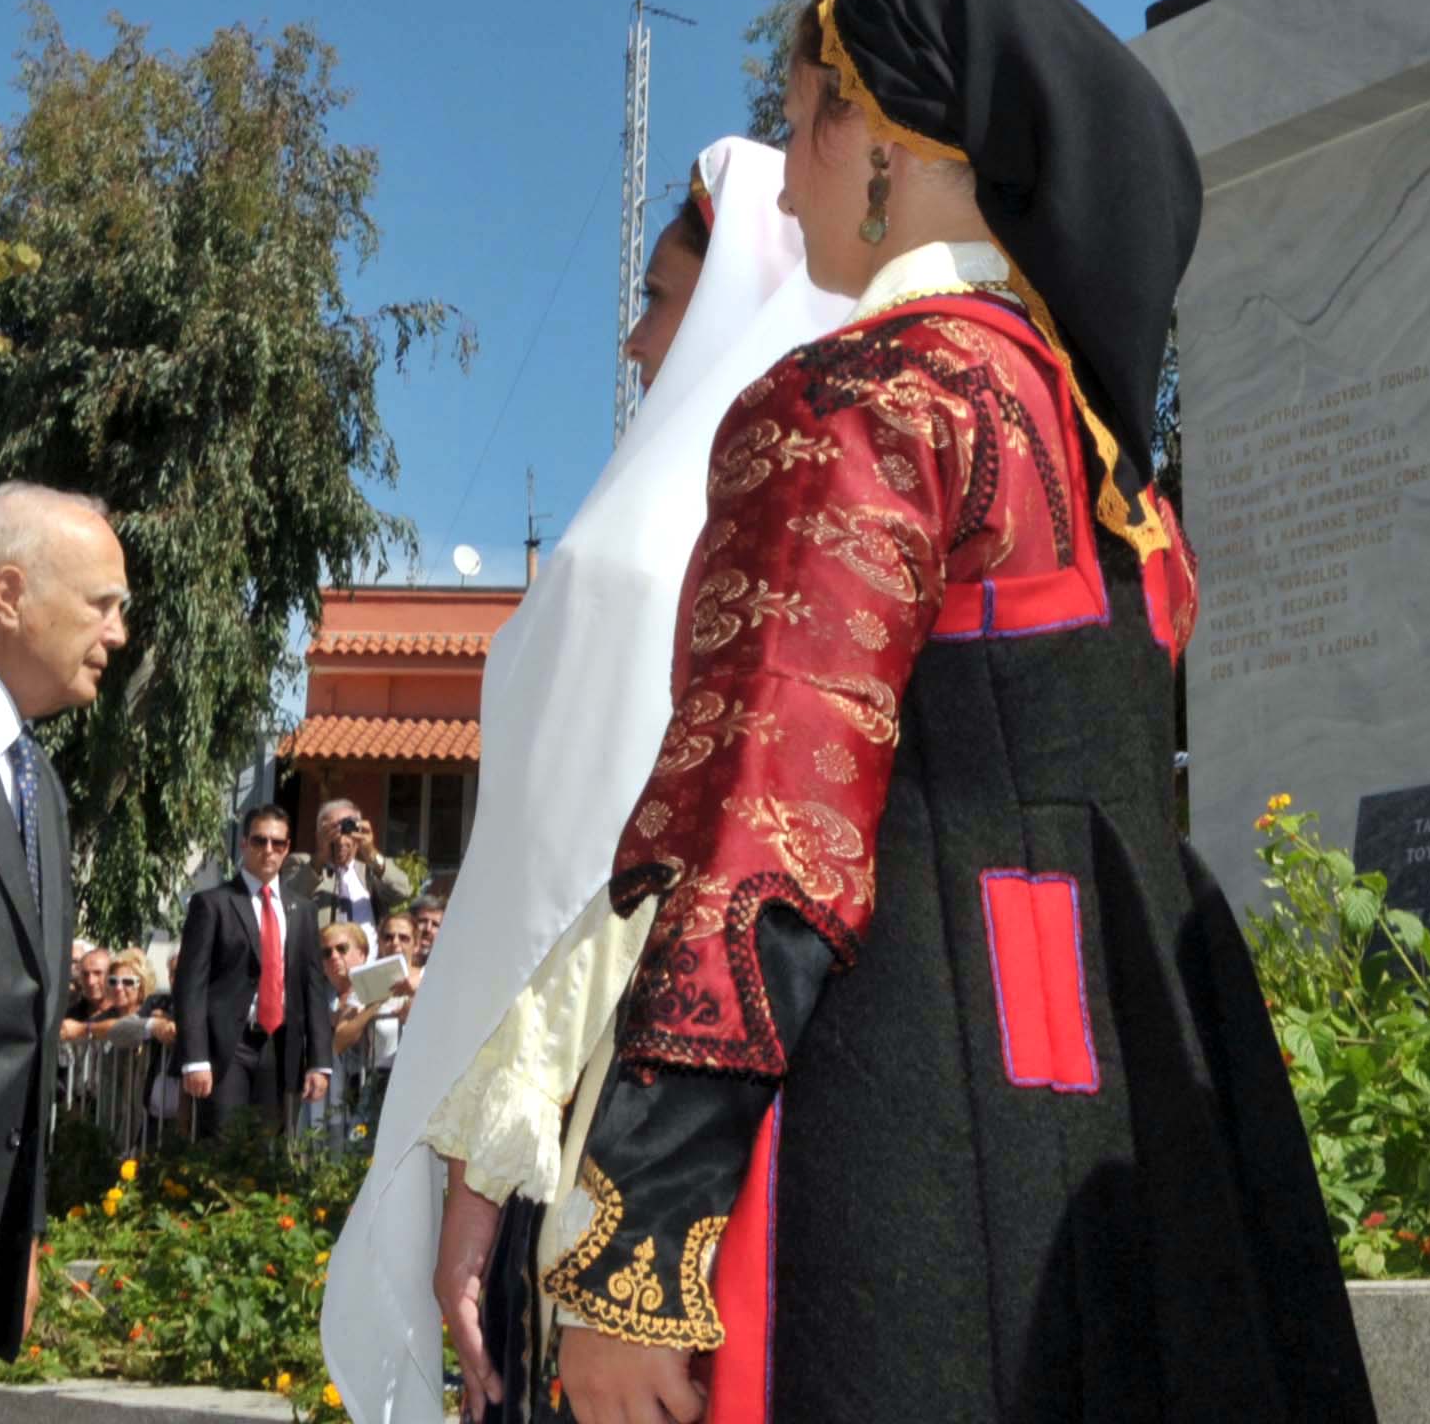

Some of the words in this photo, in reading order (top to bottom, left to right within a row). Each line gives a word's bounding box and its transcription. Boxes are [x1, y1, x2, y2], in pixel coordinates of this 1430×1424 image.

[1277, 443, 1329, 472] CARMEN
[1337, 422, 1396, 456] CONSTAN
[1210, 661, 1235, 681] GUS
[1259, 651, 1292, 671] JOHN
